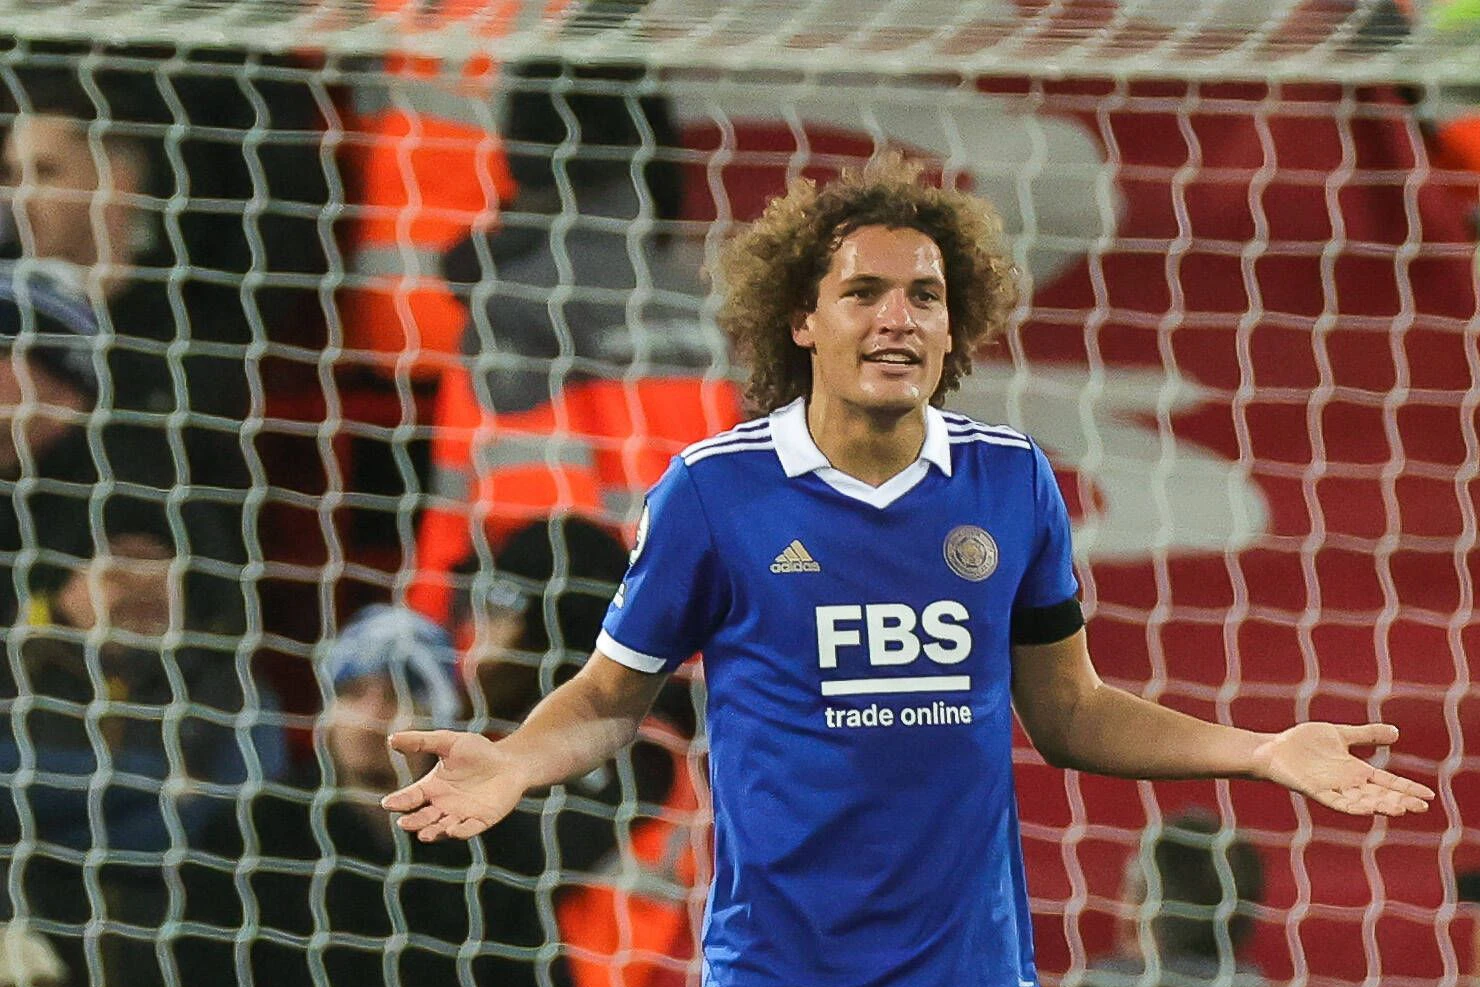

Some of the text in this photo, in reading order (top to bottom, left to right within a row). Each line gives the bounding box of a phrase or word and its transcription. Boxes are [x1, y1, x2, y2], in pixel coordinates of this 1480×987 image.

[769, 560, 821, 574] adidas
[815, 600, 972, 668] FBS
[825, 701, 972, 728] trade online
